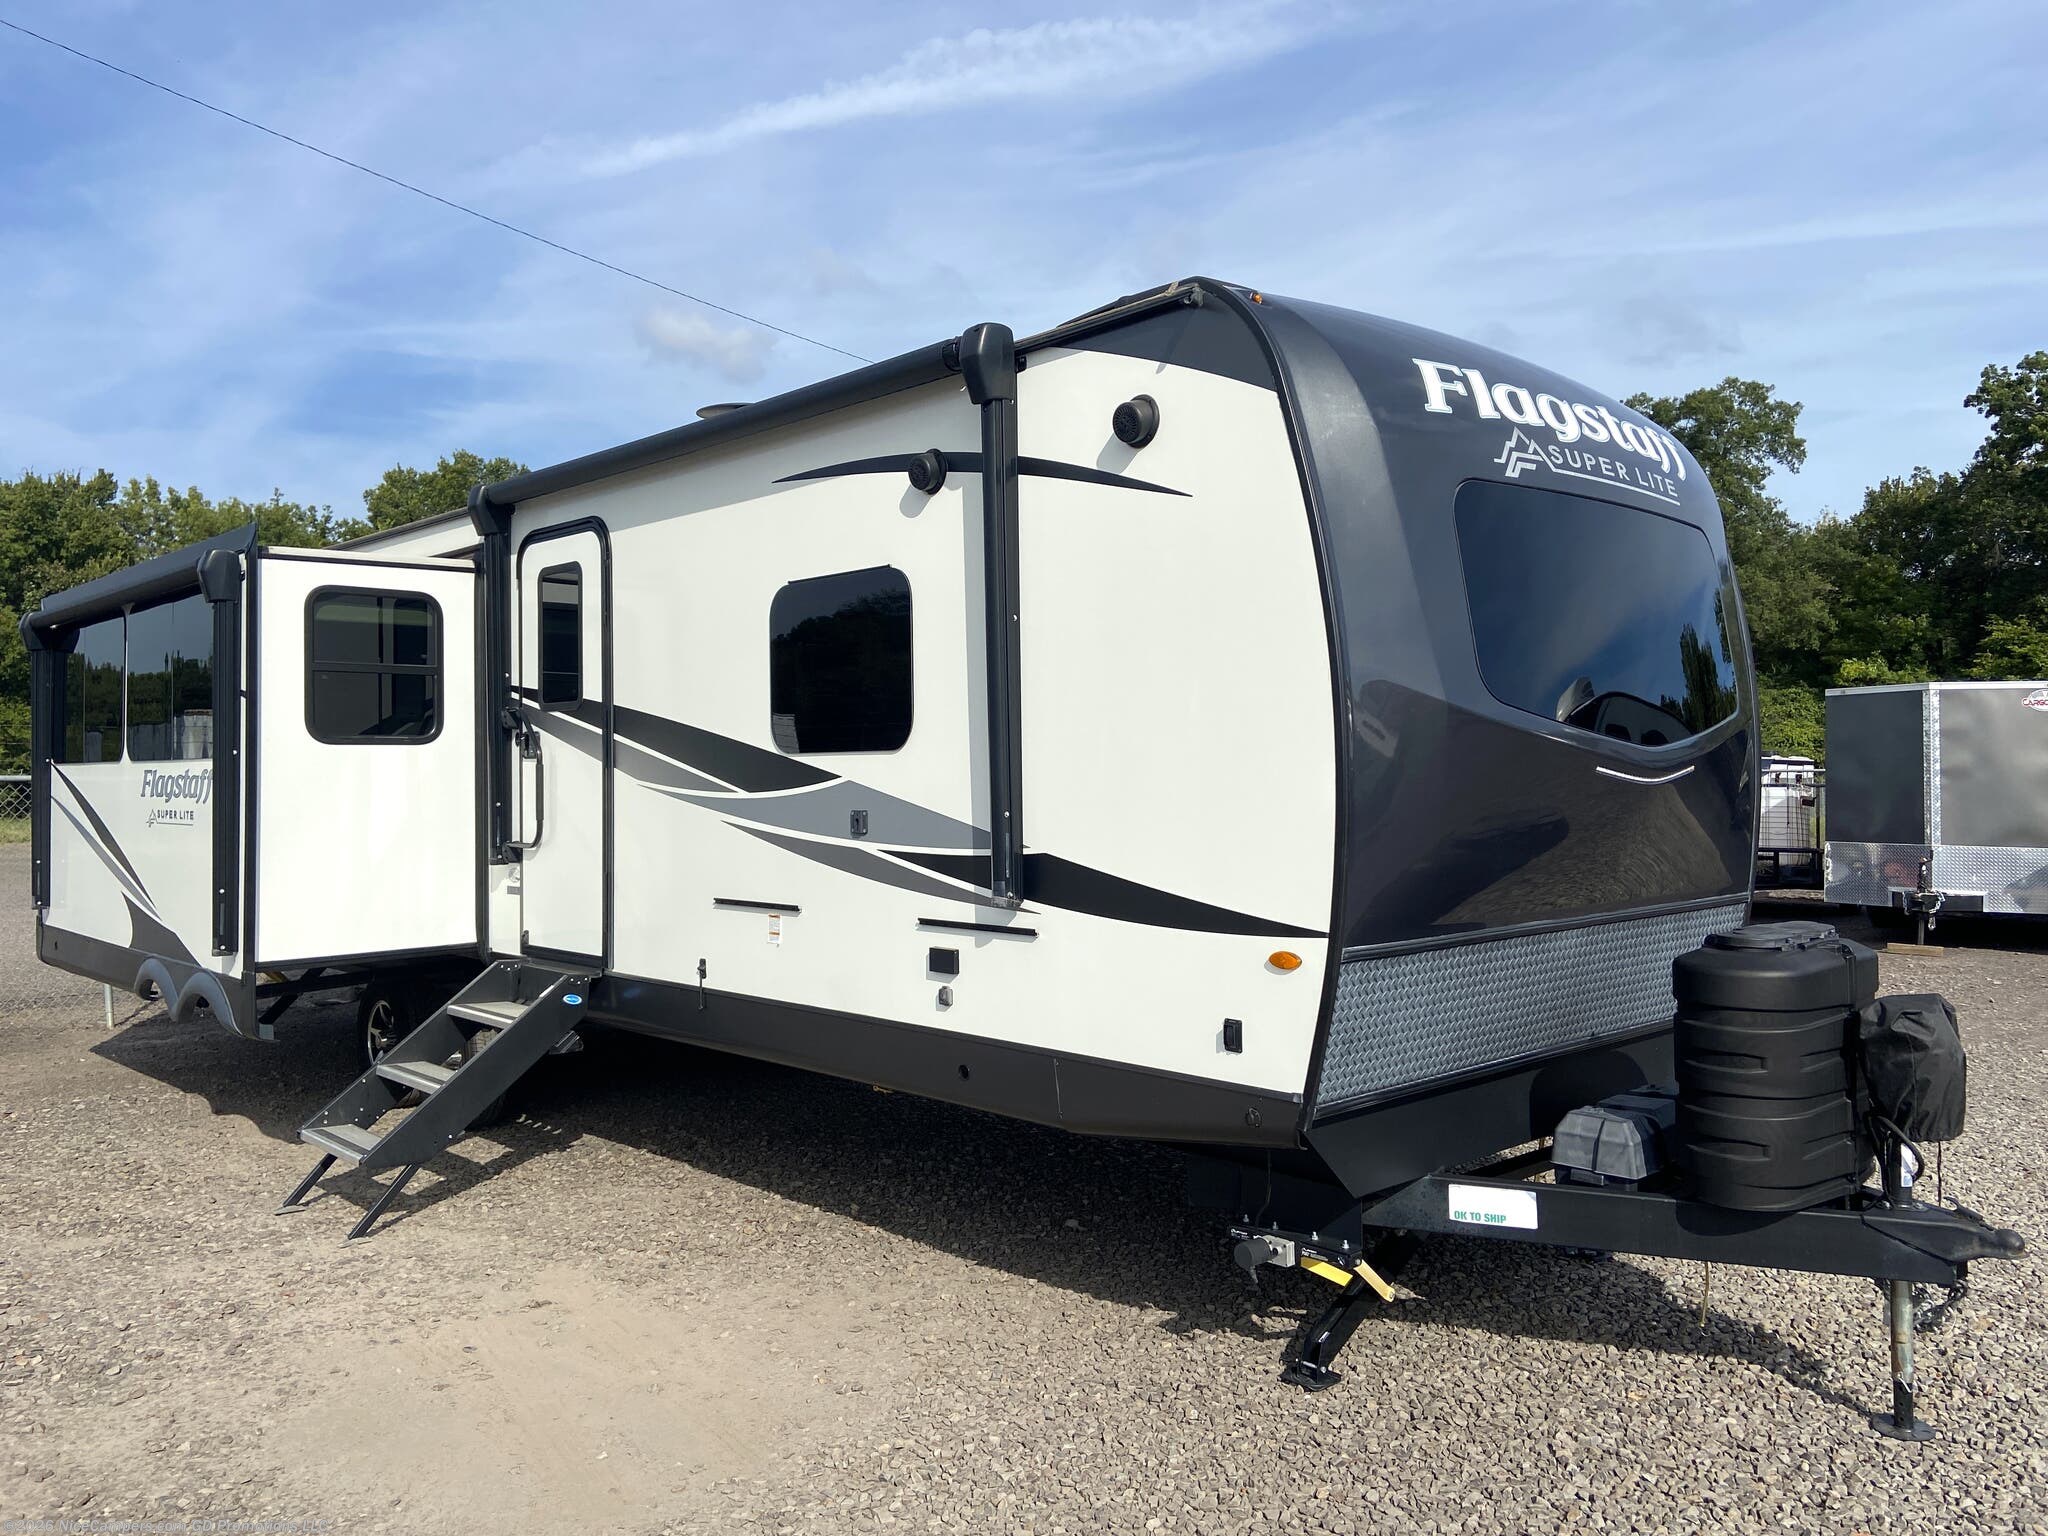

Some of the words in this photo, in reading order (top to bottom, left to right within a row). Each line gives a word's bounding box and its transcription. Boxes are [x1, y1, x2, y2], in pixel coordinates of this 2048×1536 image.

[1412, 358, 1686, 481] Flagstaff
[1548, 445, 1630, 481] SUPER
[1635, 467, 1678, 497] LITE
[140, 768, 213, 804] Flagstaff
[157, 809, 177, 819] SUPER
[179, 810, 194, 820] LITE
[1454, 1210, 1467, 1221] OK
[1469, 1211, 1481, 1222] TO
[1484, 1213, 1506, 1224] SHIP
